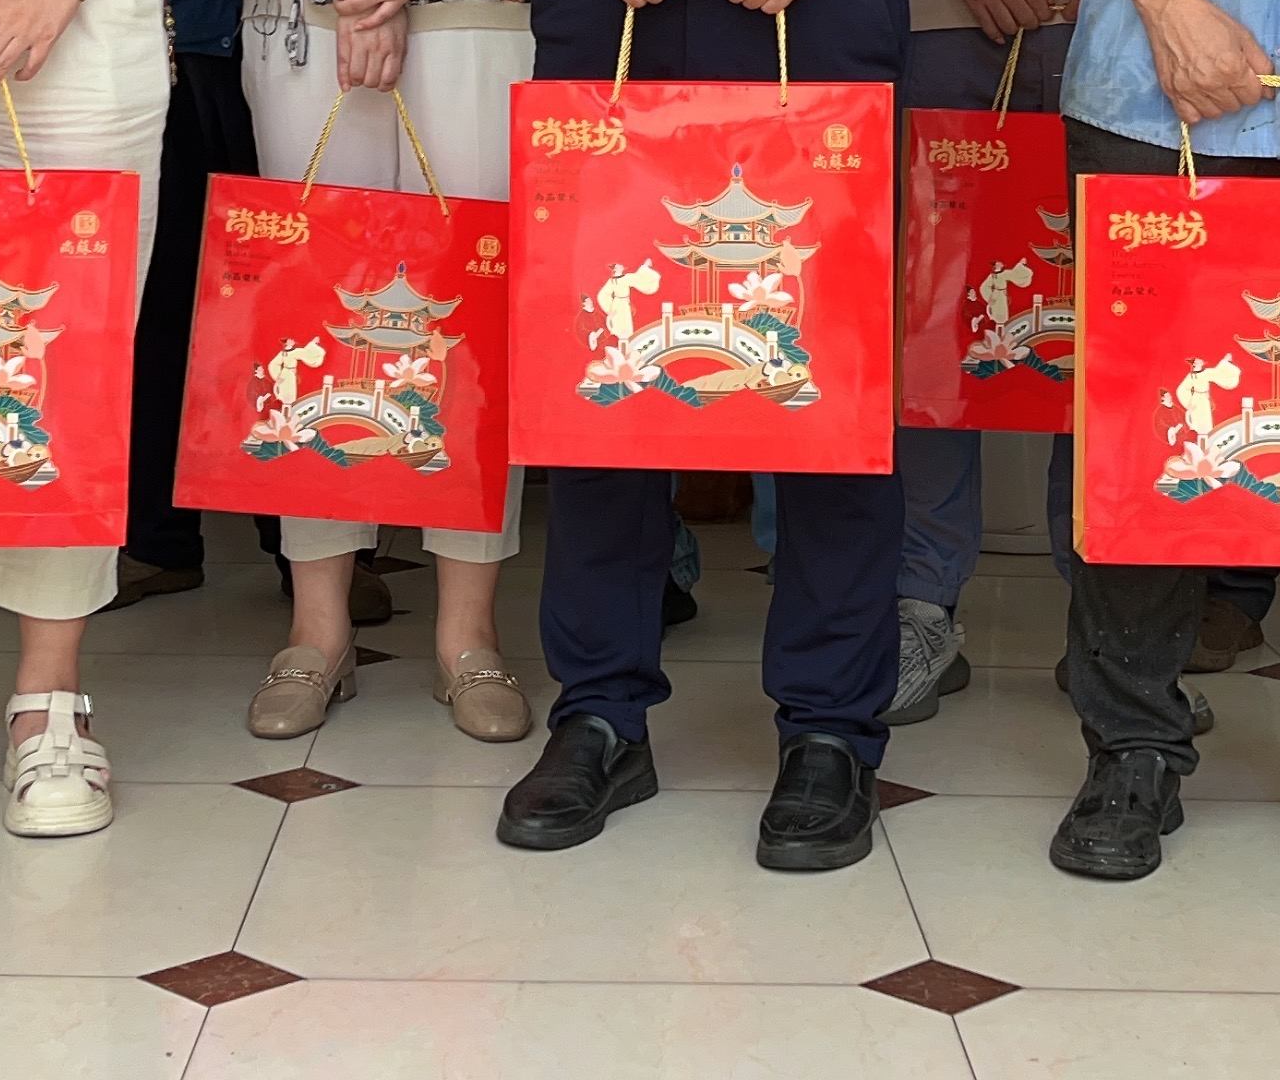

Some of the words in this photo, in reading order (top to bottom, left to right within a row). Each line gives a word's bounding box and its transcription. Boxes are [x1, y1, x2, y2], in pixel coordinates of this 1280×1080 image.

[531, 116, 627, 159] 尚蘇坊
[927, 138, 1010, 172] 尚蘇坊
[226, 208, 311, 245] 尚蘇坊
[1108, 210, 1208, 251] 尚蘇坊
